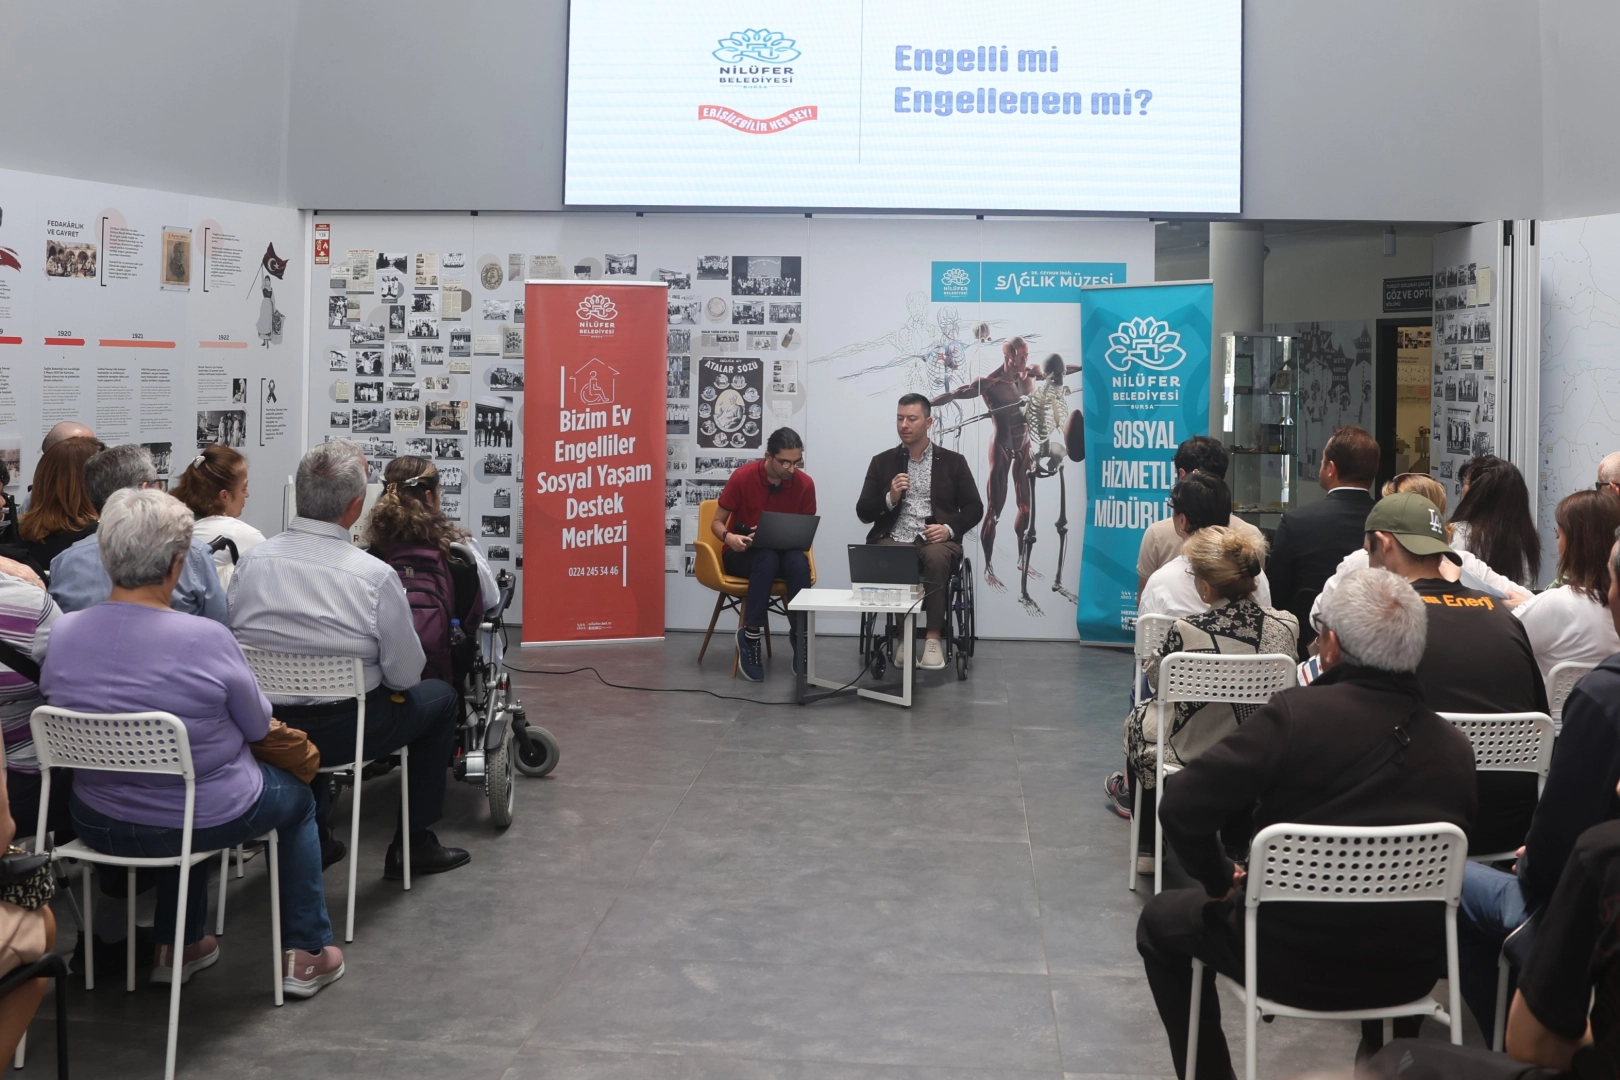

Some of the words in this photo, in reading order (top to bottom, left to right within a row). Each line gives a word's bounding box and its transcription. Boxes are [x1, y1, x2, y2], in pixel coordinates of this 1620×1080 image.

[719, 65, 794, 75] NİLÜFER
[895, 45, 1008, 75] Engelli
[1018, 45, 1059, 72] mi
[894, 87, 1082, 117] Engellenen
[1091, 88, 1153, 115] mi?
[769, 117, 791, 130] HER
[789, 108, 812, 123] ŞEY!
[47, 219, 84, 229] FEDAKÂRLIK
[56, 229, 79, 237] GAYRET
[995, 271, 1055, 295] SAĞLIK
[1060, 272, 1113, 287] MÜZESİ
[1386, 289, 1401, 300] GÖZ
[1402, 290, 1412, 299] VE
[1413, 286, 1431, 298] OPTİ
[704, 360, 734, 373] ATALAR
[737, 361, 758, 373] SÖZÜ
[1112, 373, 1181, 387] NİLÜFER
[1112, 390, 1179, 401] BELEDİYESİ
[560, 408, 607, 433] Bizim
[612, 405, 632, 427] Ev
[1113, 420, 1179, 449] SOSYAL
[555, 435, 636, 464] Engelliler
[537, 466, 592, 495] Sosyal
[597, 463, 652, 488] Yaşam
[566, 493, 624, 520] Destek
[1428, 508, 1442, 534] LA
[562, 520, 628, 550] Merkezi
[569, 567, 585, 576] 0224
[586, 566, 598, 576] 245
[600, 566, 608, 575] 34
[610, 566, 618, 575] 46
[1442, 594, 1495, 610] Enerji
